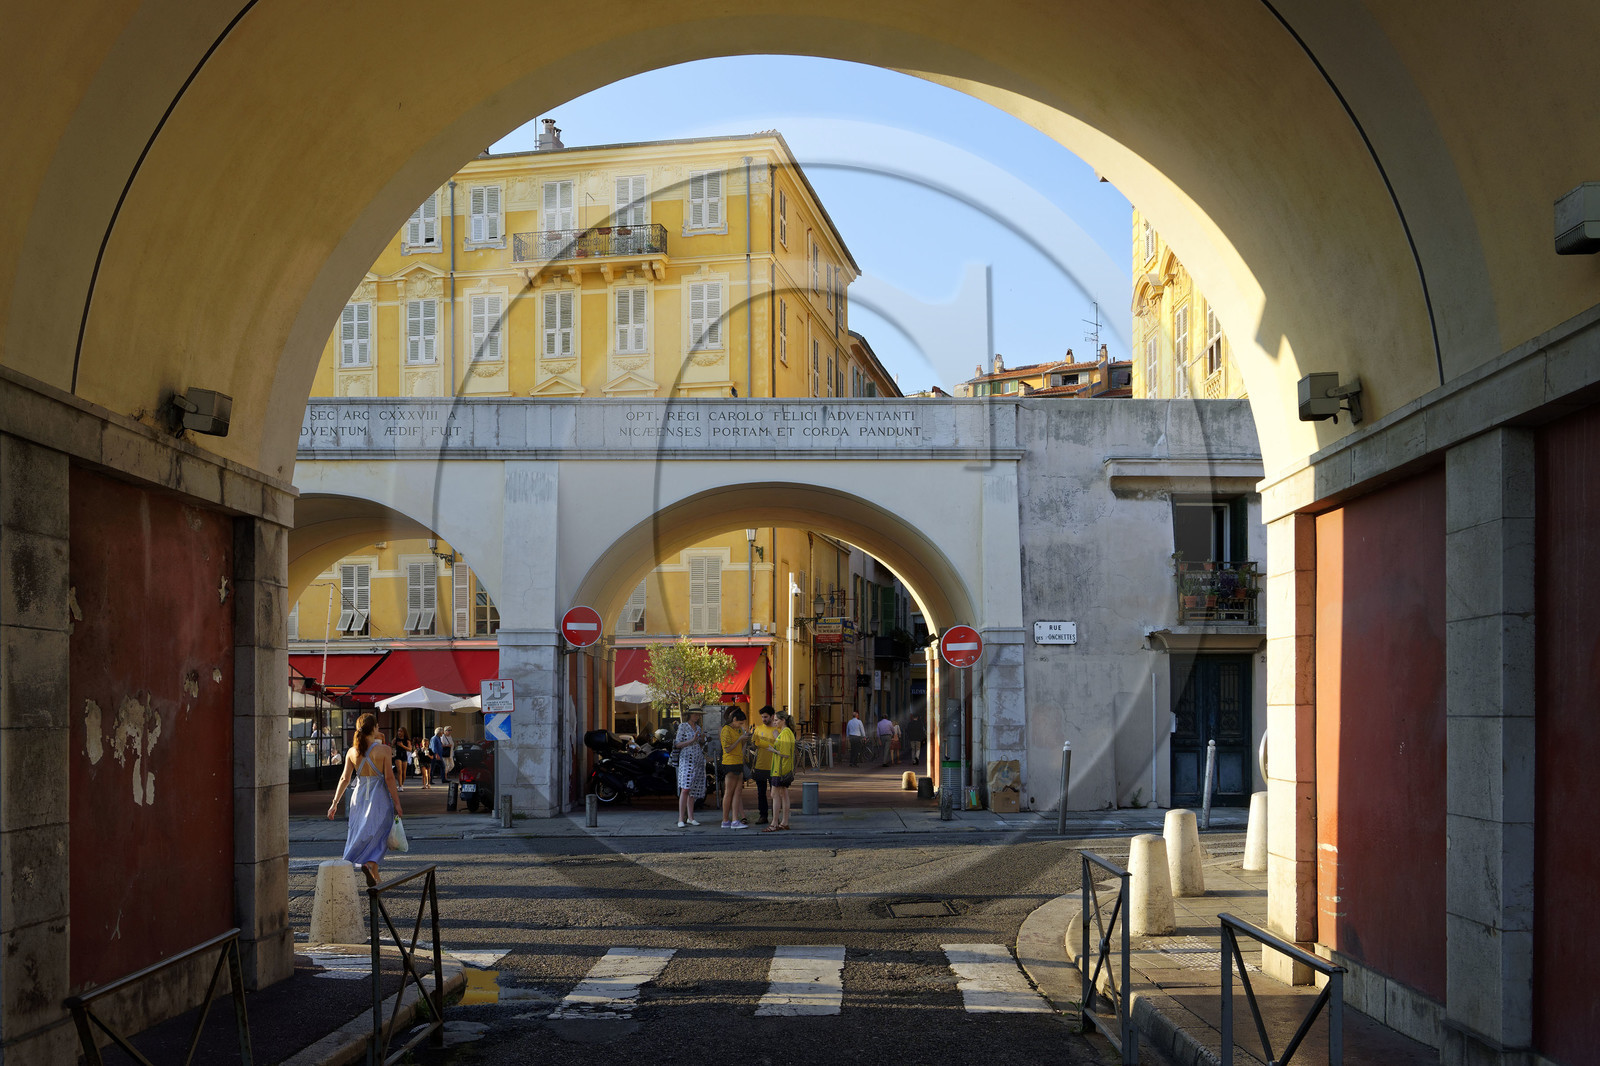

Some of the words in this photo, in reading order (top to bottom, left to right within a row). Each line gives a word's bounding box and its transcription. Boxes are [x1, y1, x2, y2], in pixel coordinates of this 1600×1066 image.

[379, 411, 438, 420] CXXXVIII
[667, 411, 699, 421] REGI
[709, 411, 764, 421] CAROLO
[774, 411, 817, 421] FELICI
[828, 411, 916, 421] ADVENTANTI
[432, 427, 461, 436] FUIT
[713, 427, 769, 437] PORTAM
[777, 427, 796, 437] ET
[803, 427, 850, 437] CORDA
[860, 427, 922, 437] PANDUNT
